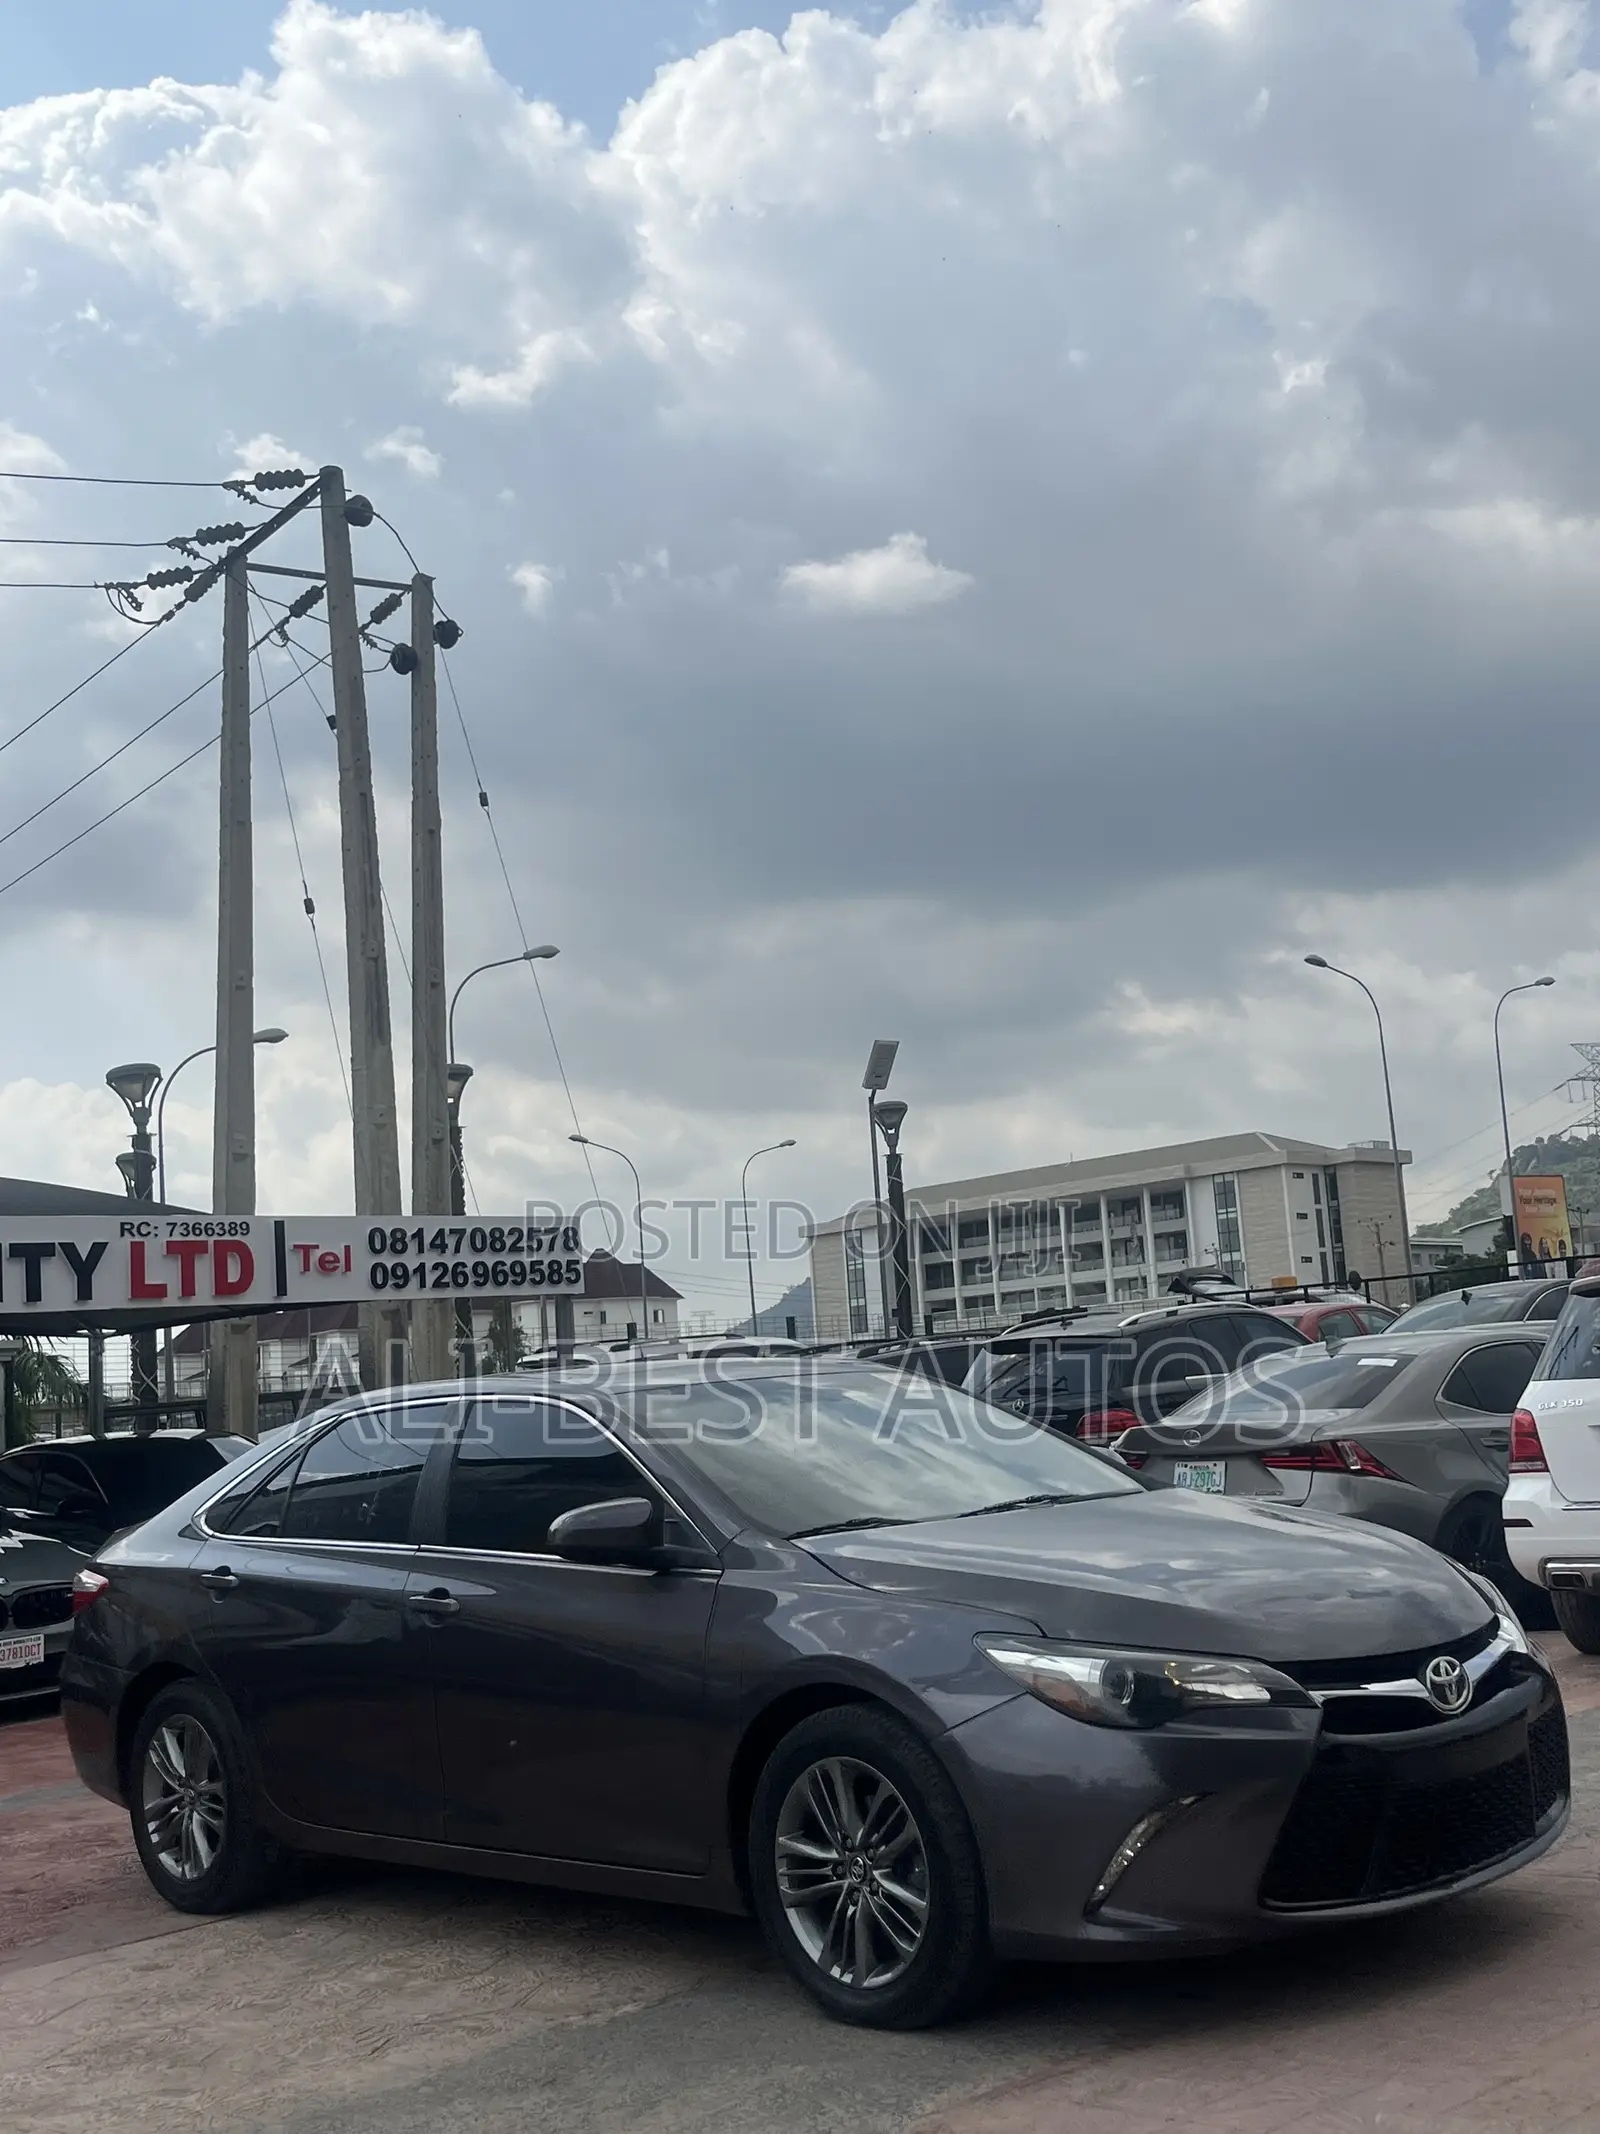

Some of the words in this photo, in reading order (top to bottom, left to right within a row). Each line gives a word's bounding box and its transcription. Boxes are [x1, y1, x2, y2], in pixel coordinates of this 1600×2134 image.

[119, 1221, 159, 1237] RC:
[166, 1221, 250, 1237] 7366389
[368, 1227, 580, 1254] 08147082578
[0, 1241, 109, 1303] TY
[129, 1239, 255, 1298] LTD
[292, 1244, 351, 1273] Tel
[370, 1260, 581, 1289] 09126969585
[1538, 1402, 1557, 1410] GLK
[1561, 1398, 1583, 1408] 350
